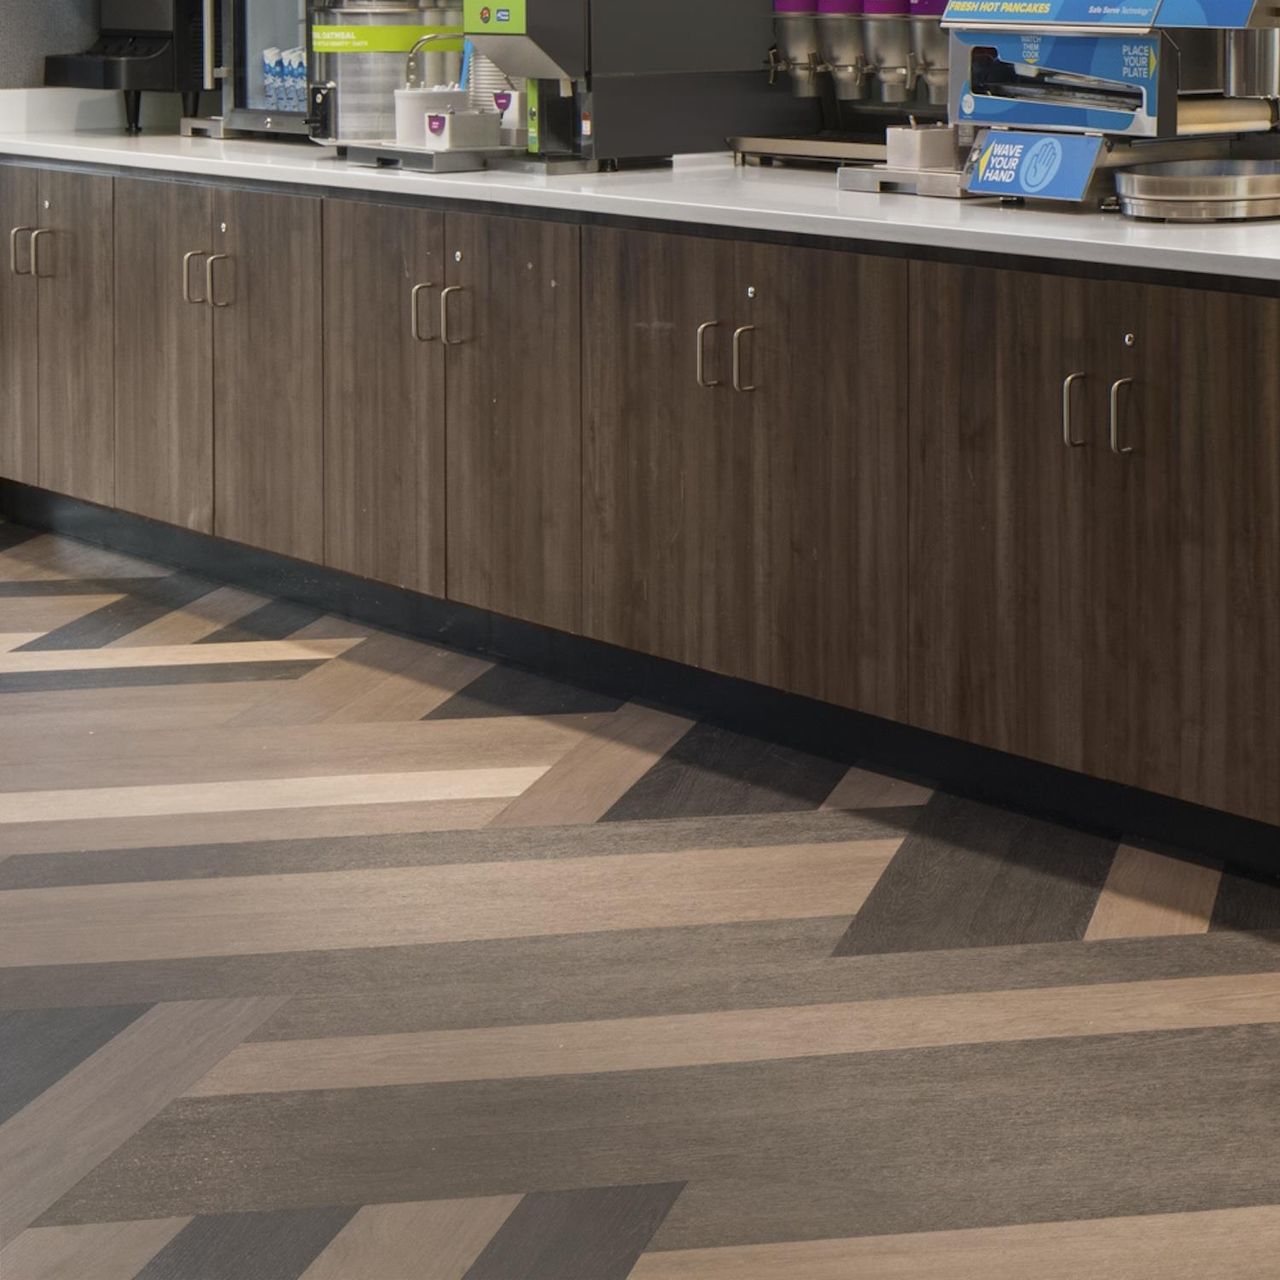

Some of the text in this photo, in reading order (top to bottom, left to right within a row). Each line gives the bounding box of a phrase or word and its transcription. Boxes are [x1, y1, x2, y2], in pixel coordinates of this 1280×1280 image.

[949, 1, 1051, 14] FRESH HOT PANCAKES
[1020, 36, 1042, 44] WATCH
[1023, 43, 1039, 51] THEM
[1122, 44, 1150, 56] PLACE
[1022, 50, 1040, 59] COOK
[1123, 56, 1149, 67] YOUR
[1122, 66, 1149, 79] PLATE
[992, 143, 1024, 157] WAVE
[989, 157, 1020, 170] YOUR
[983, 169, 1016, 183] HAND
